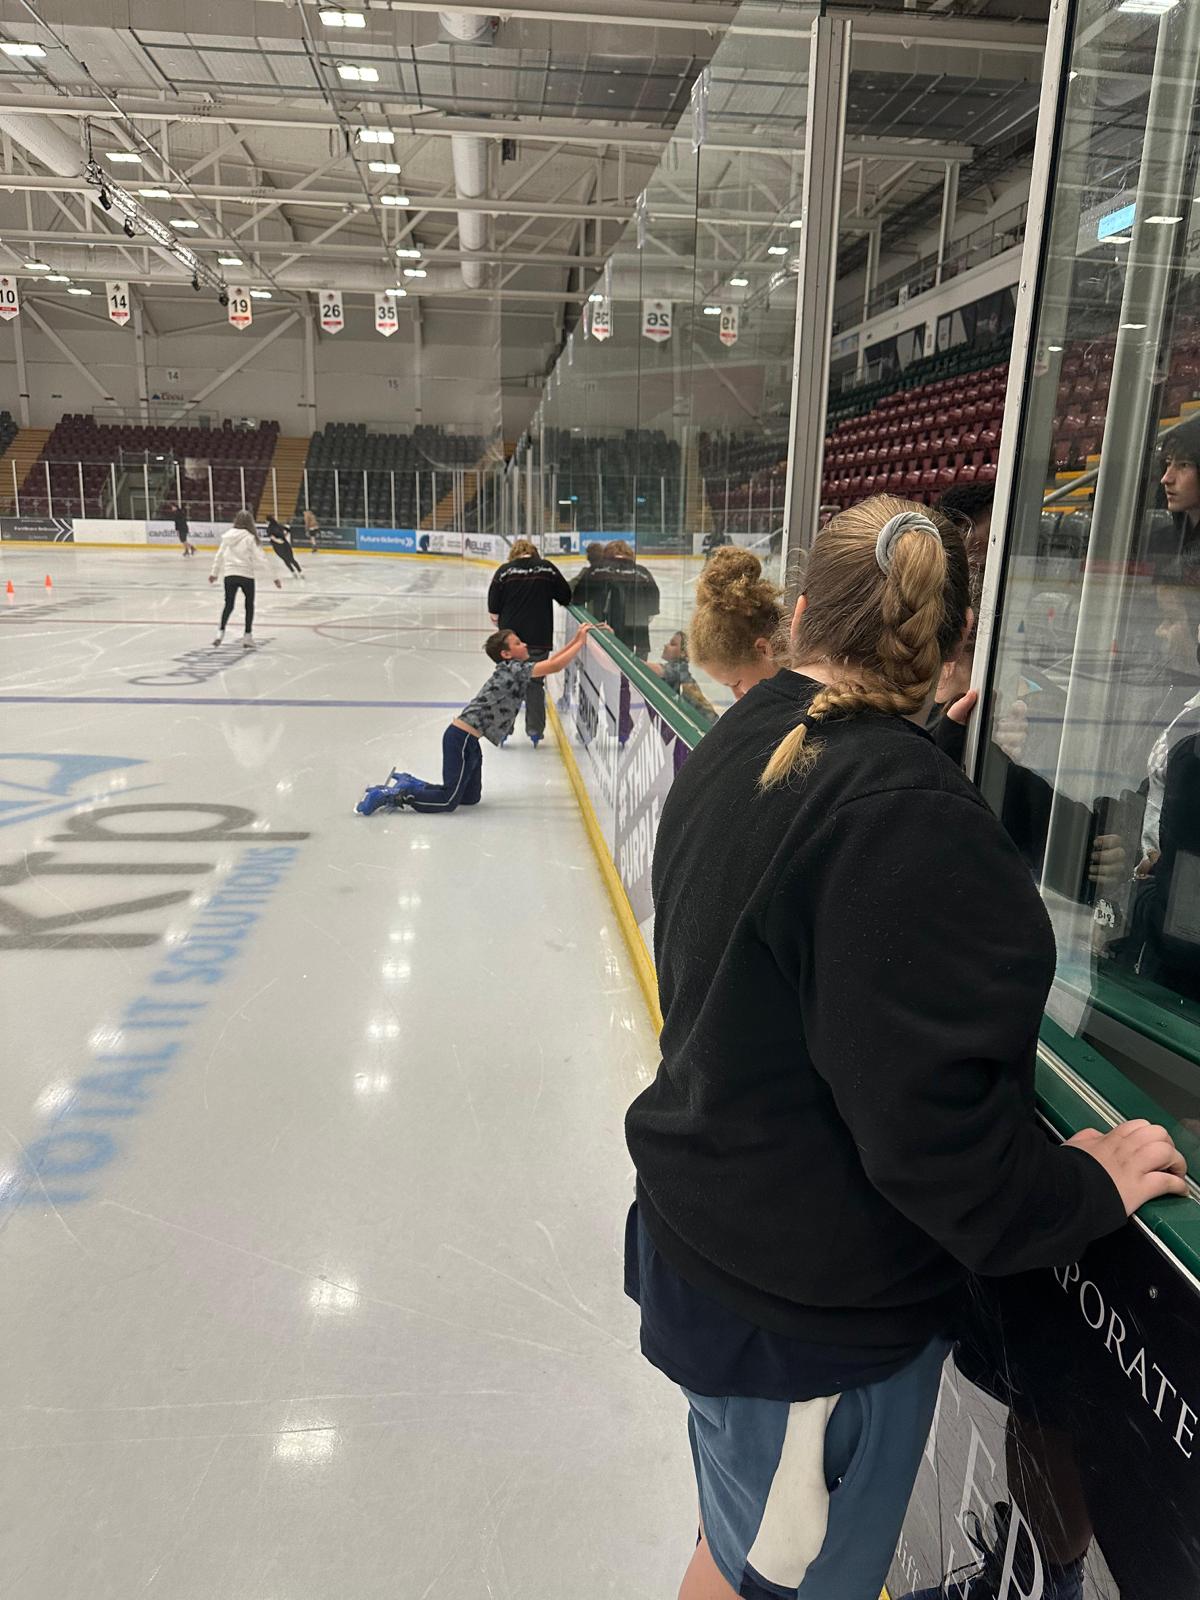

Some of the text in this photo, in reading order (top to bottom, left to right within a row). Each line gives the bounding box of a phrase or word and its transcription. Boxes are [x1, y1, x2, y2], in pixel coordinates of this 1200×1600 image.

[0, 289, 15, 304] 10
[111, 294, 127, 309] 14
[230, 299, 248, 314] 19
[322, 304, 341, 318] 26
[378, 306, 395, 320] 35
[150, 845, 299, 986] SOLUTIONS
